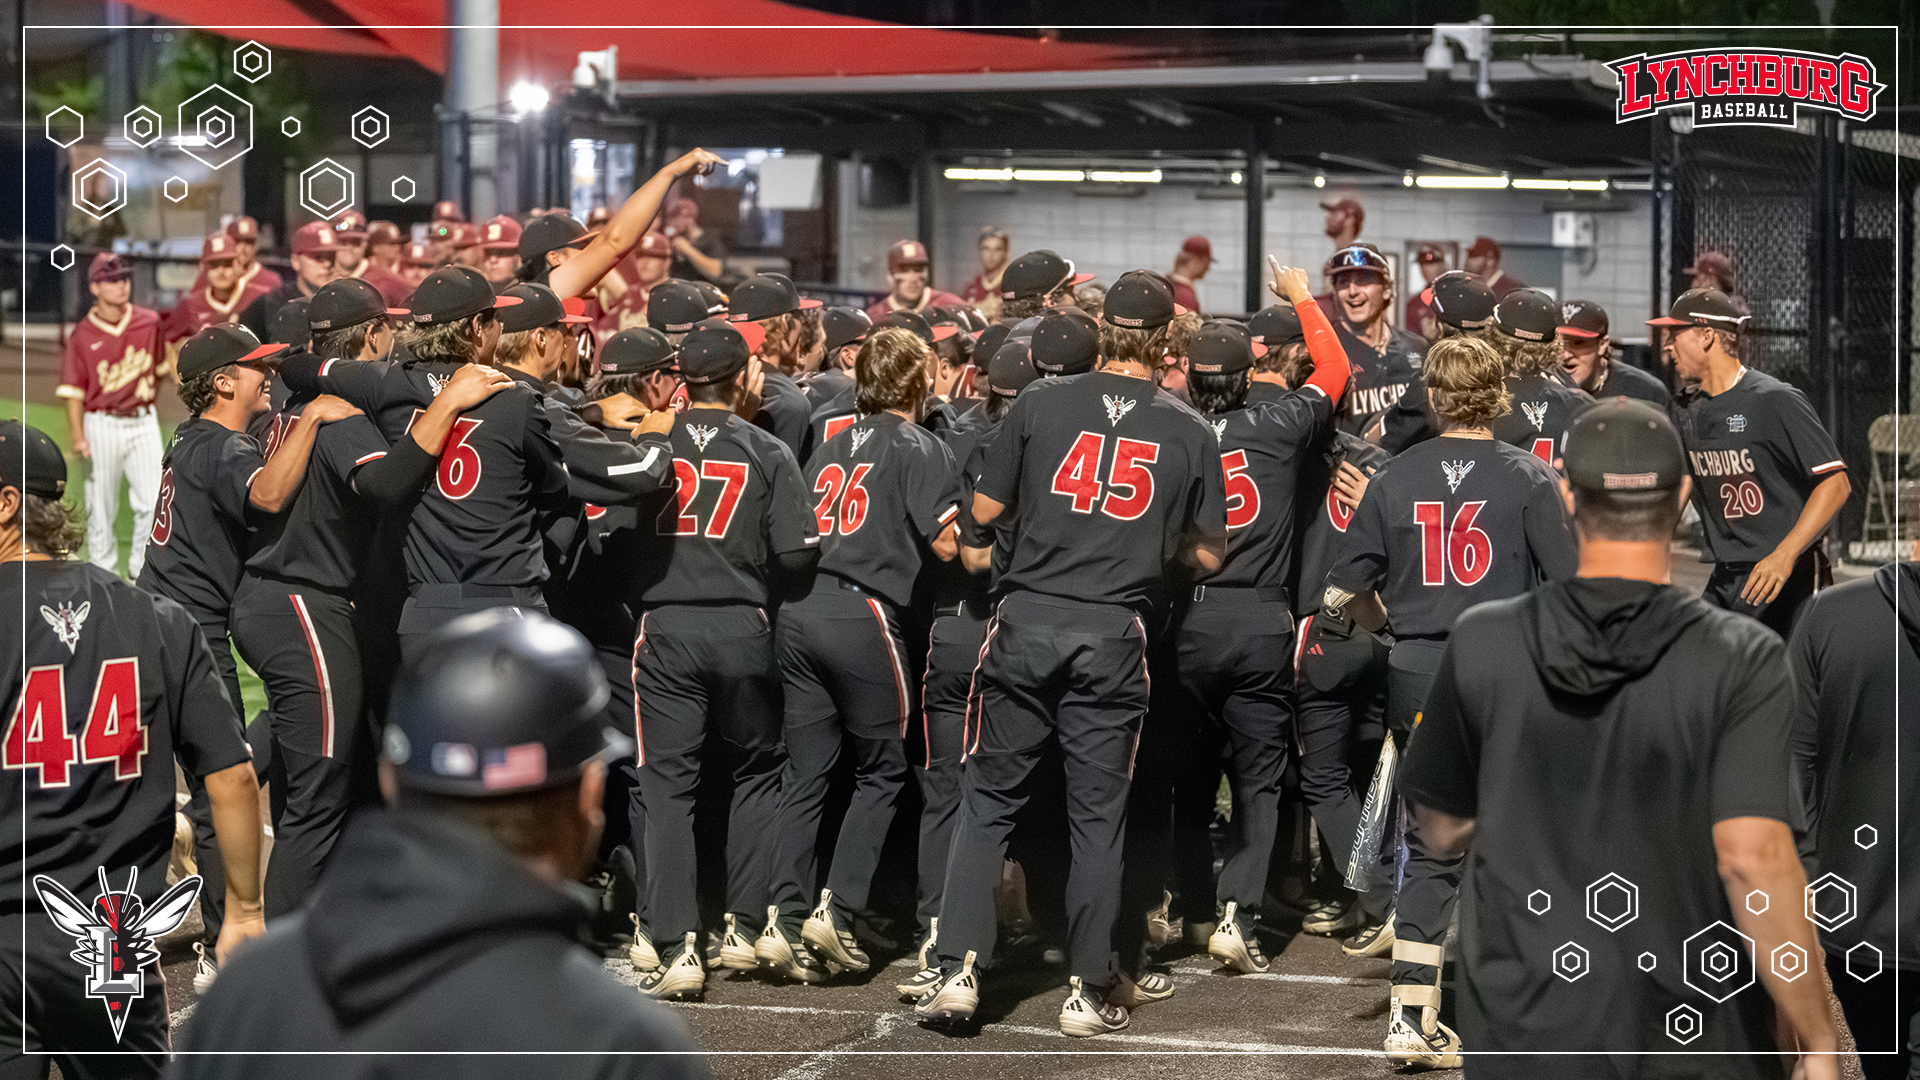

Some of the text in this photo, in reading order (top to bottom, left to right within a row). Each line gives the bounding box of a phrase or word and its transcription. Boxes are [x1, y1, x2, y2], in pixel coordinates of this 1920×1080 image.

[1352, 382, 1410, 416] LYNCHB
[147, 461, 176, 546] 3
[656, 457, 750, 539] 27
[813, 462, 875, 536] 26
[1050, 430, 1161, 521] 45
[1689, 448, 1756, 477] NCHBURG
[1720, 480, 1764, 519] 20
[1413, 500, 1493, 587] 16
[1, 656, 149, 789] 44
